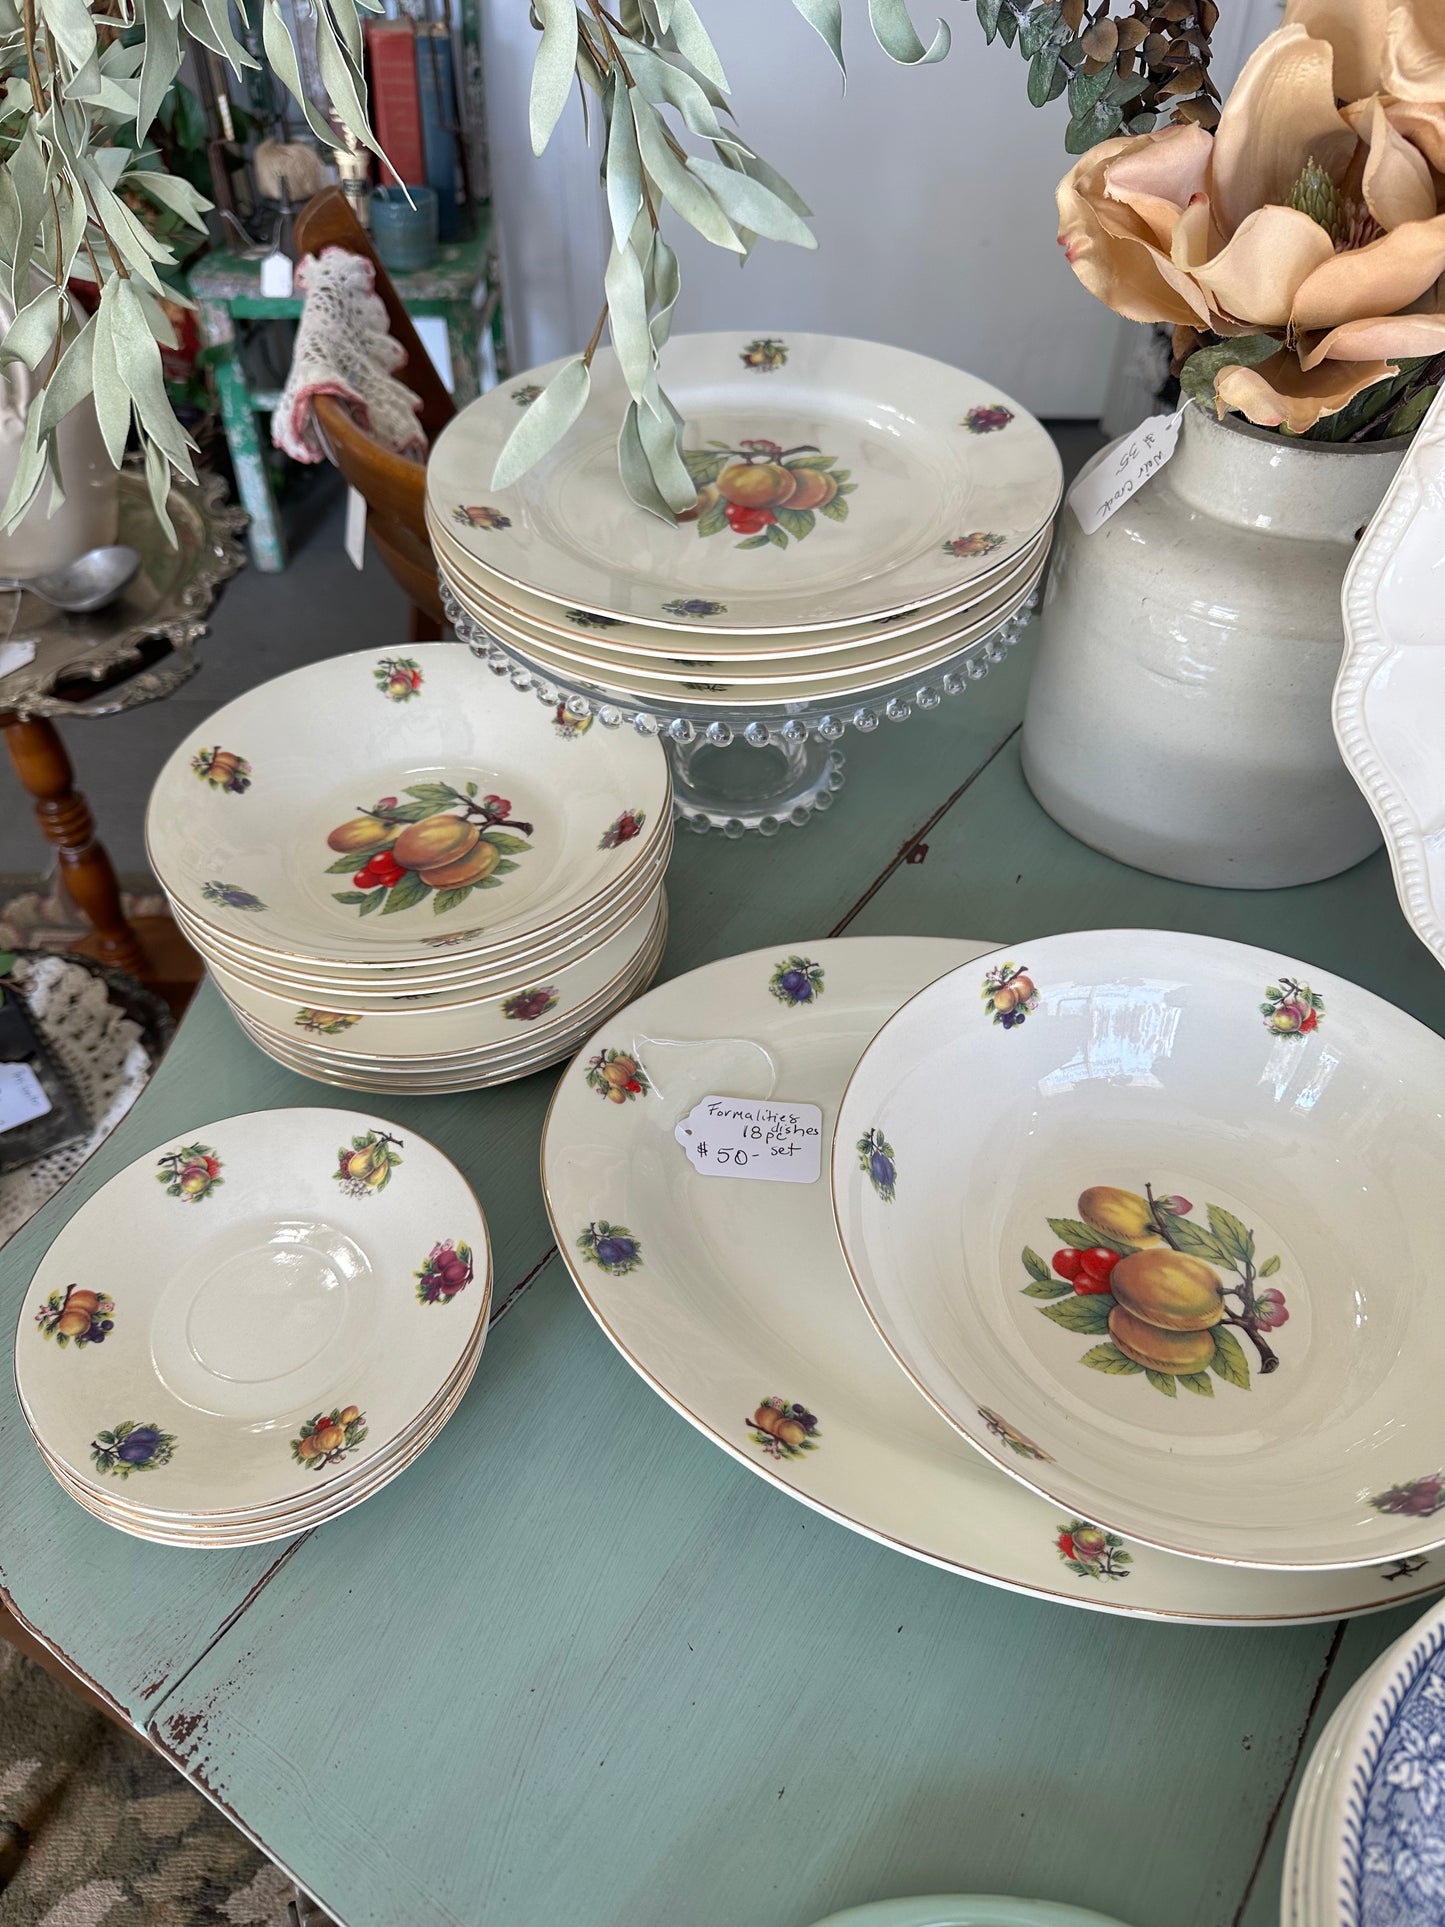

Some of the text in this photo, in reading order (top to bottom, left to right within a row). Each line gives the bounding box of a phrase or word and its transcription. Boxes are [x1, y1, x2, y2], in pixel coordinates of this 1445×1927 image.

[707, 1101, 800, 1123] Formalities
[771, 1122, 819, 1137] dishes
[770, 1142, 802, 1156] set
